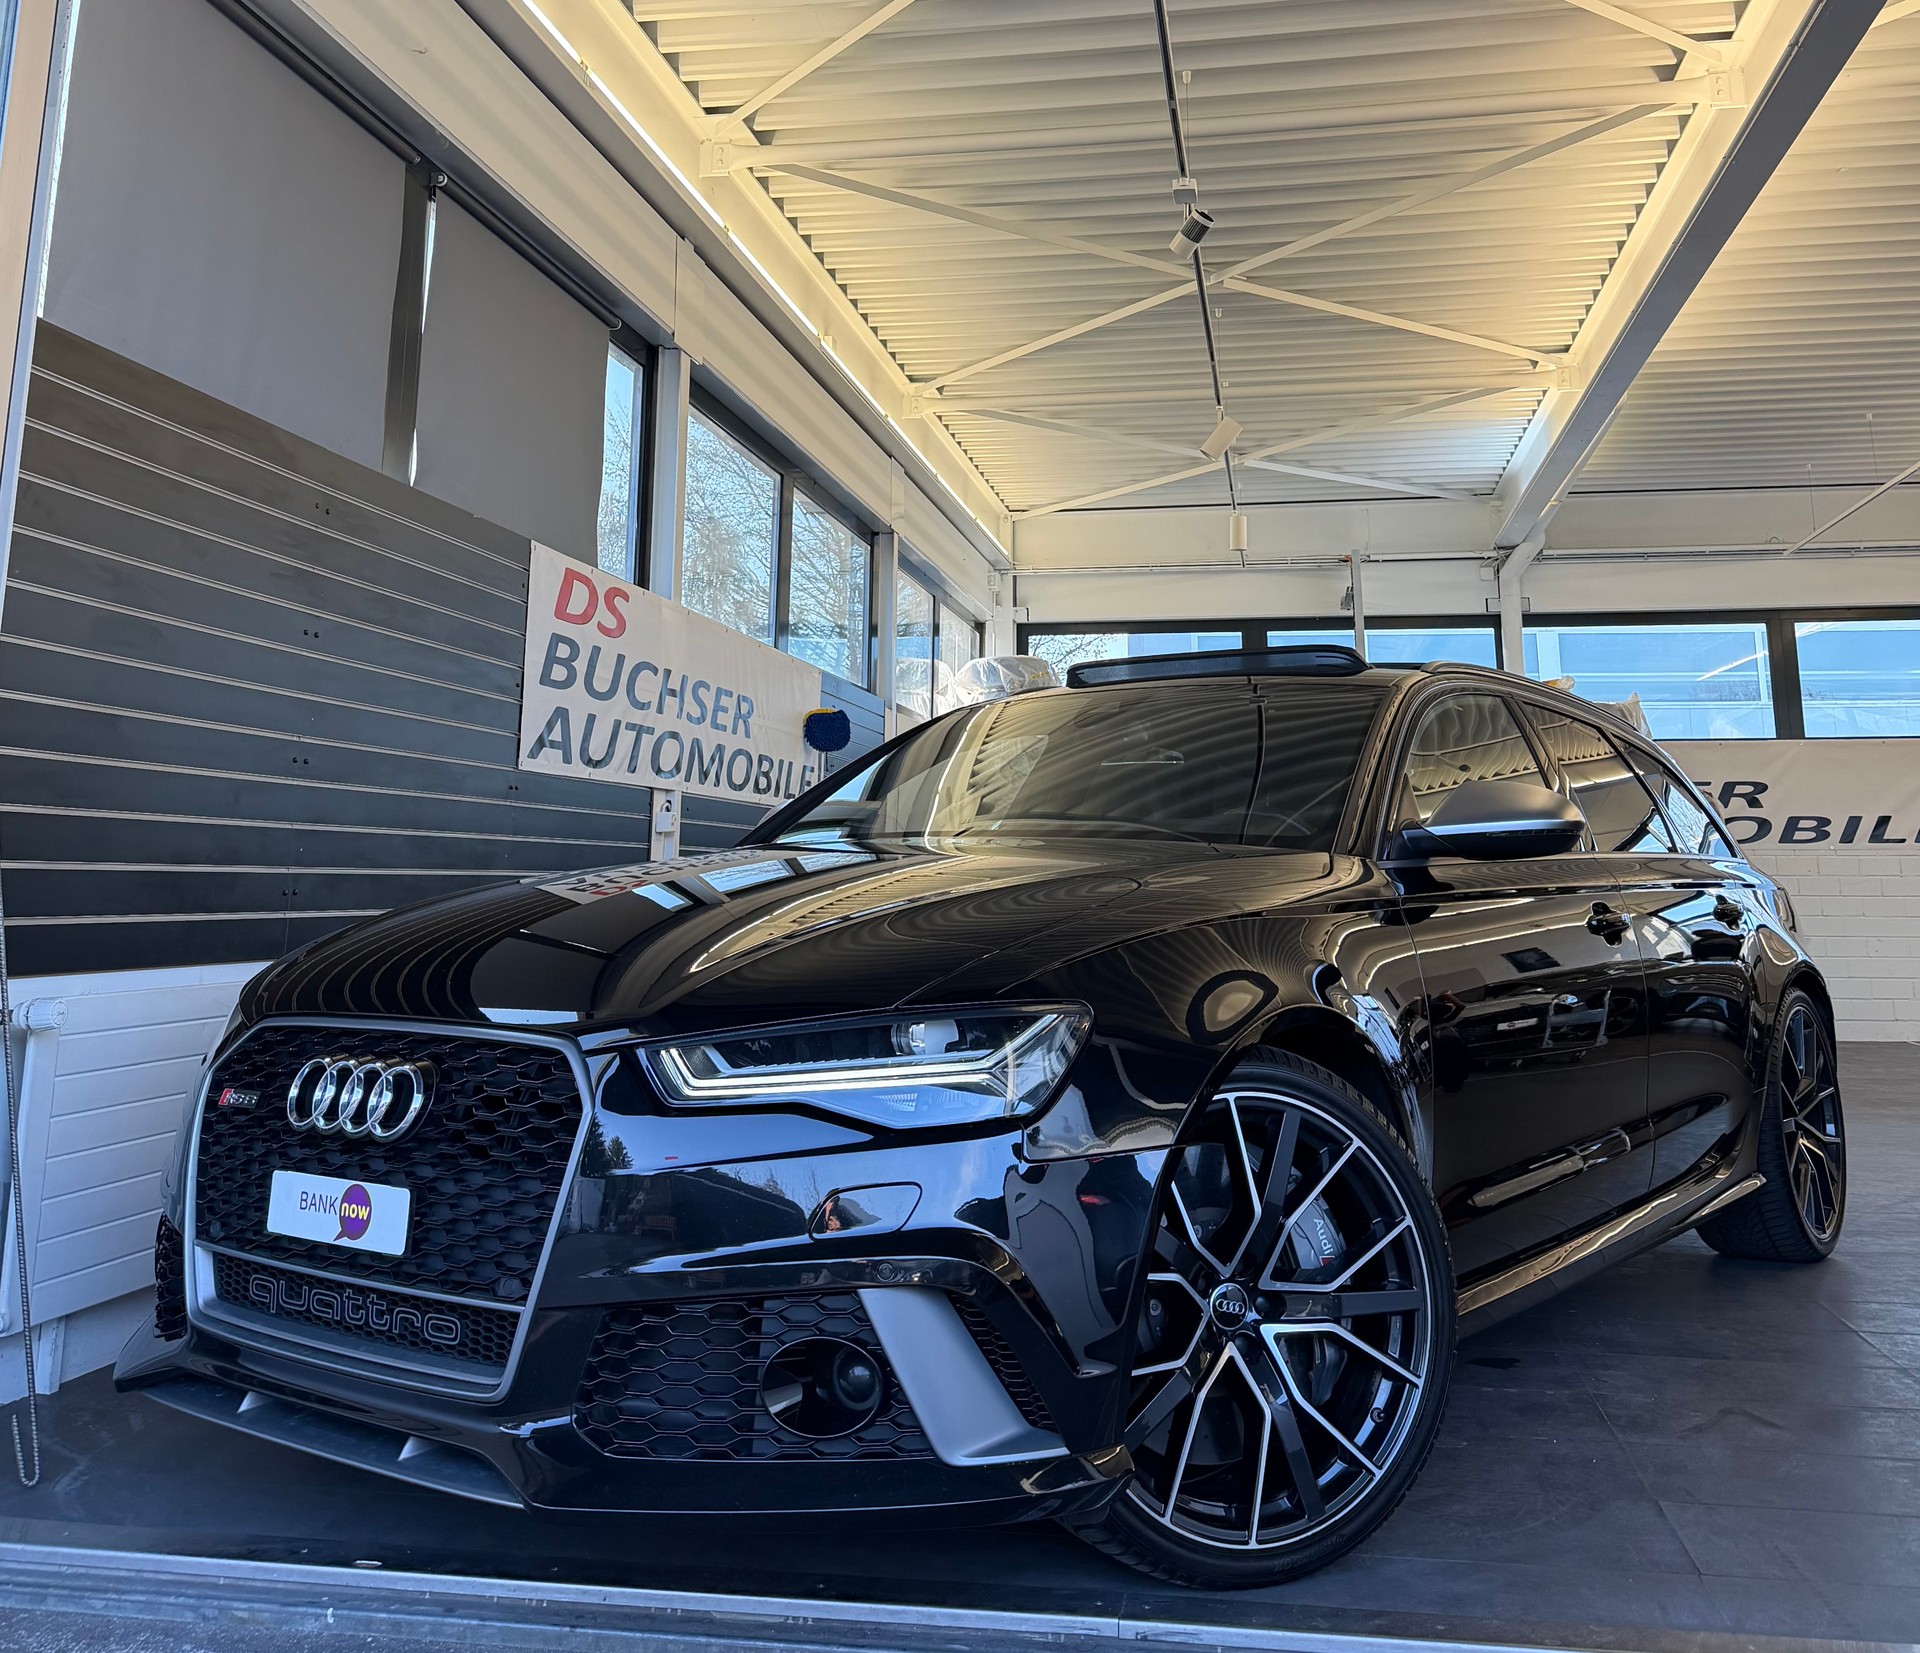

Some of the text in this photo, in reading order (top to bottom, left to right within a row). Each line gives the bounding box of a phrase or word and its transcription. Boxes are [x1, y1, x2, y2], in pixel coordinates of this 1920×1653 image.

[554, 566, 630, 639] DS
[538, 632, 755, 739] BUCHSER
[1724, 815, 1920, 844] OBIL
[299, 1191, 370, 1220] BANK now
[1313, 1218, 1334, 1255] Audi
[249, 1274, 461, 1345] quattro
